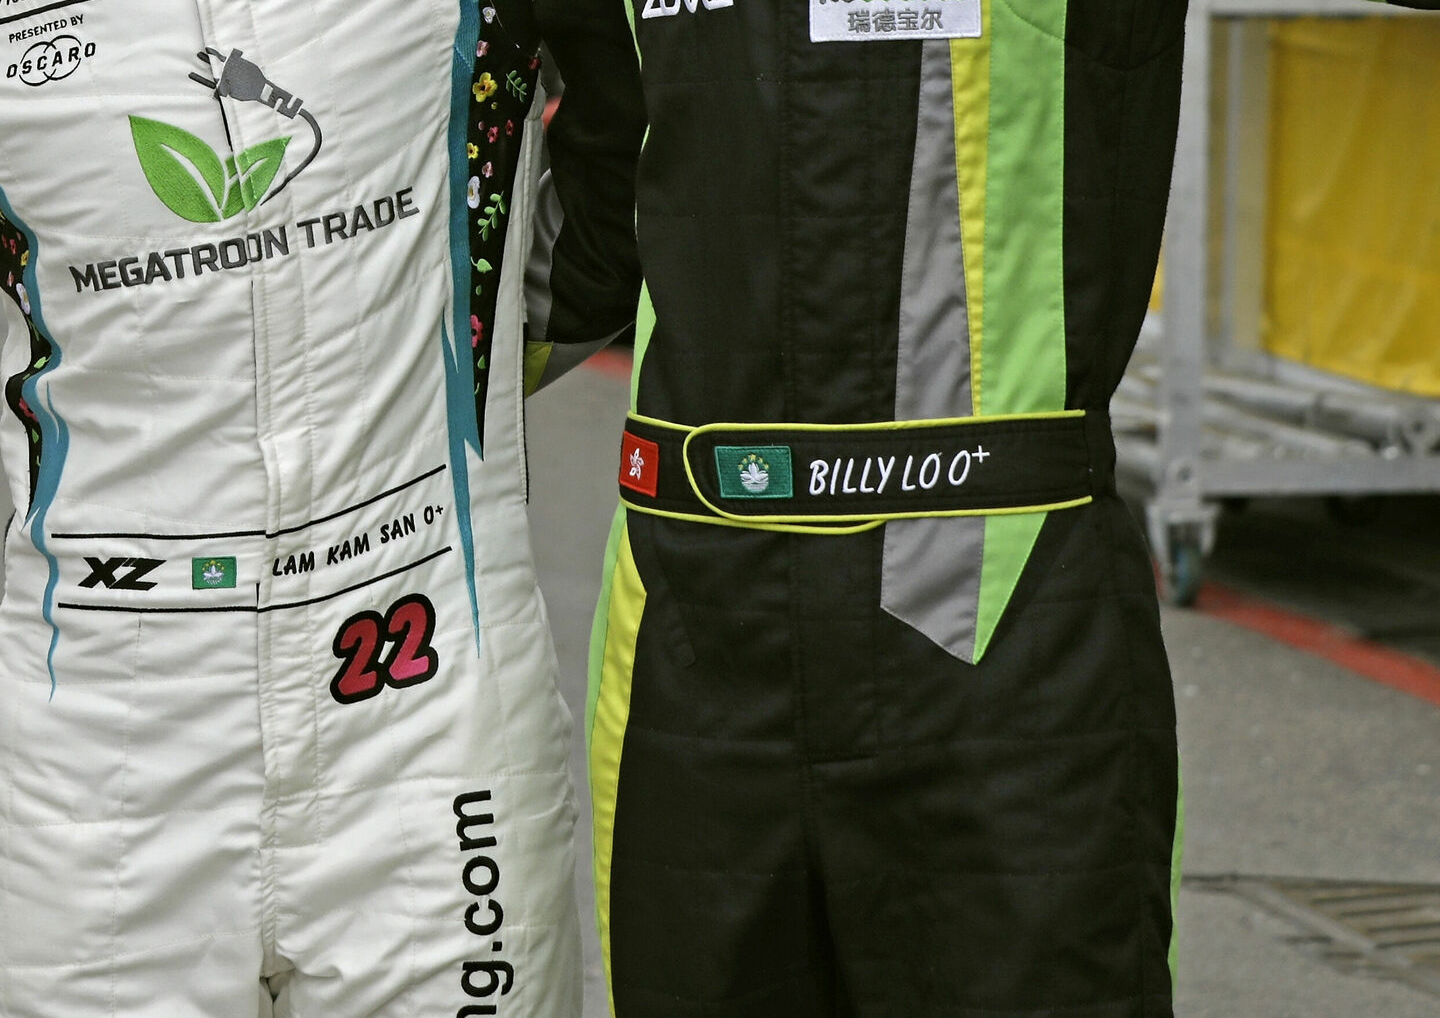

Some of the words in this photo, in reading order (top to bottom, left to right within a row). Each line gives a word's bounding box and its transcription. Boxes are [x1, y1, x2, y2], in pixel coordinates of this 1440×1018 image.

[9, 18, 67, 43] PRESENTED
[70, 14, 84, 26] BY
[846, 7, 944, 32] 瑞德宝尔
[6, 42, 96, 78] OSCARO
[296, 186, 420, 249] TRADE
[809, 455, 896, 496] BILLY
[272, 551, 315, 576] LAM
[326, 532, 370, 566] KAM
[380, 513, 416, 544] SAN
[78, 556, 167, 591] XZ
[329, 593, 439, 704] 22
